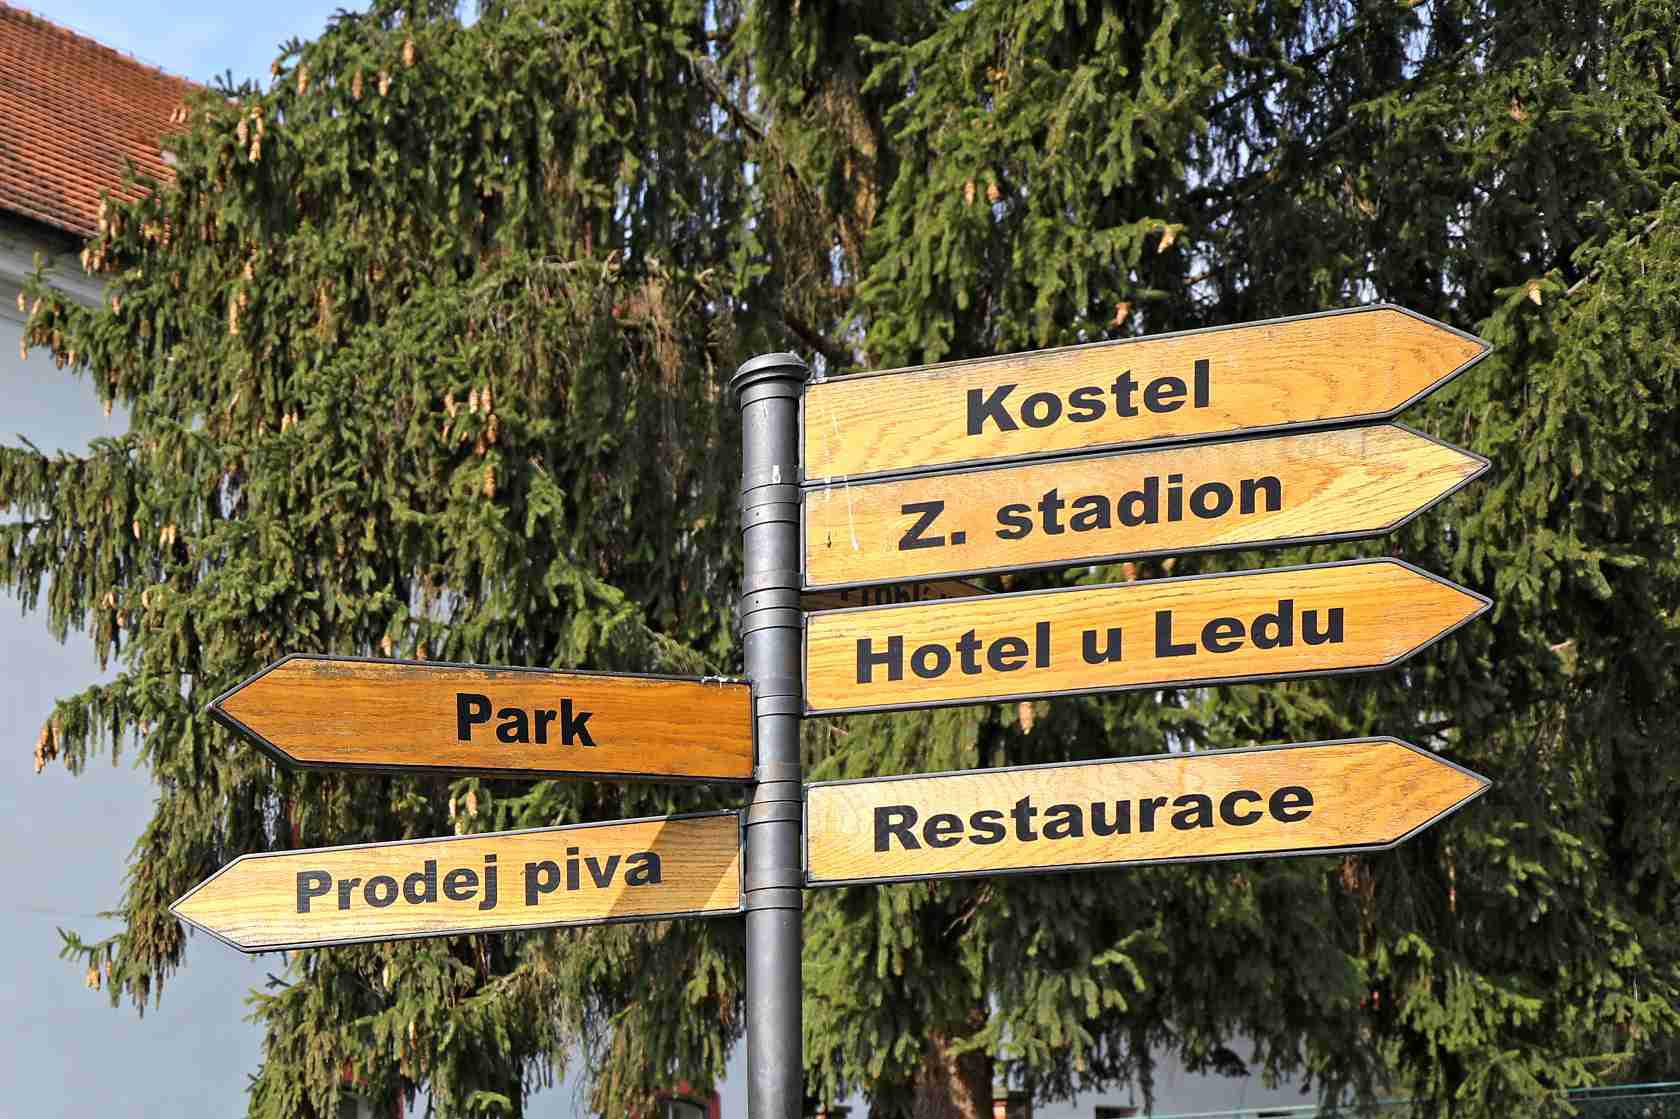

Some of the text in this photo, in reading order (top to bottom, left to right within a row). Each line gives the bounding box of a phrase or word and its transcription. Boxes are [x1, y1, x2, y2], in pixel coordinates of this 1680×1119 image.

[967, 358, 1210, 436] Kostel
[898, 473, 1282, 551] Z. stadion
[856, 598, 1344, 684] Hotel u Ledu
[455, 692, 598, 748] Park
[874, 785, 1314, 853] Restaurace
[295, 846, 663, 915] Prodej piva
